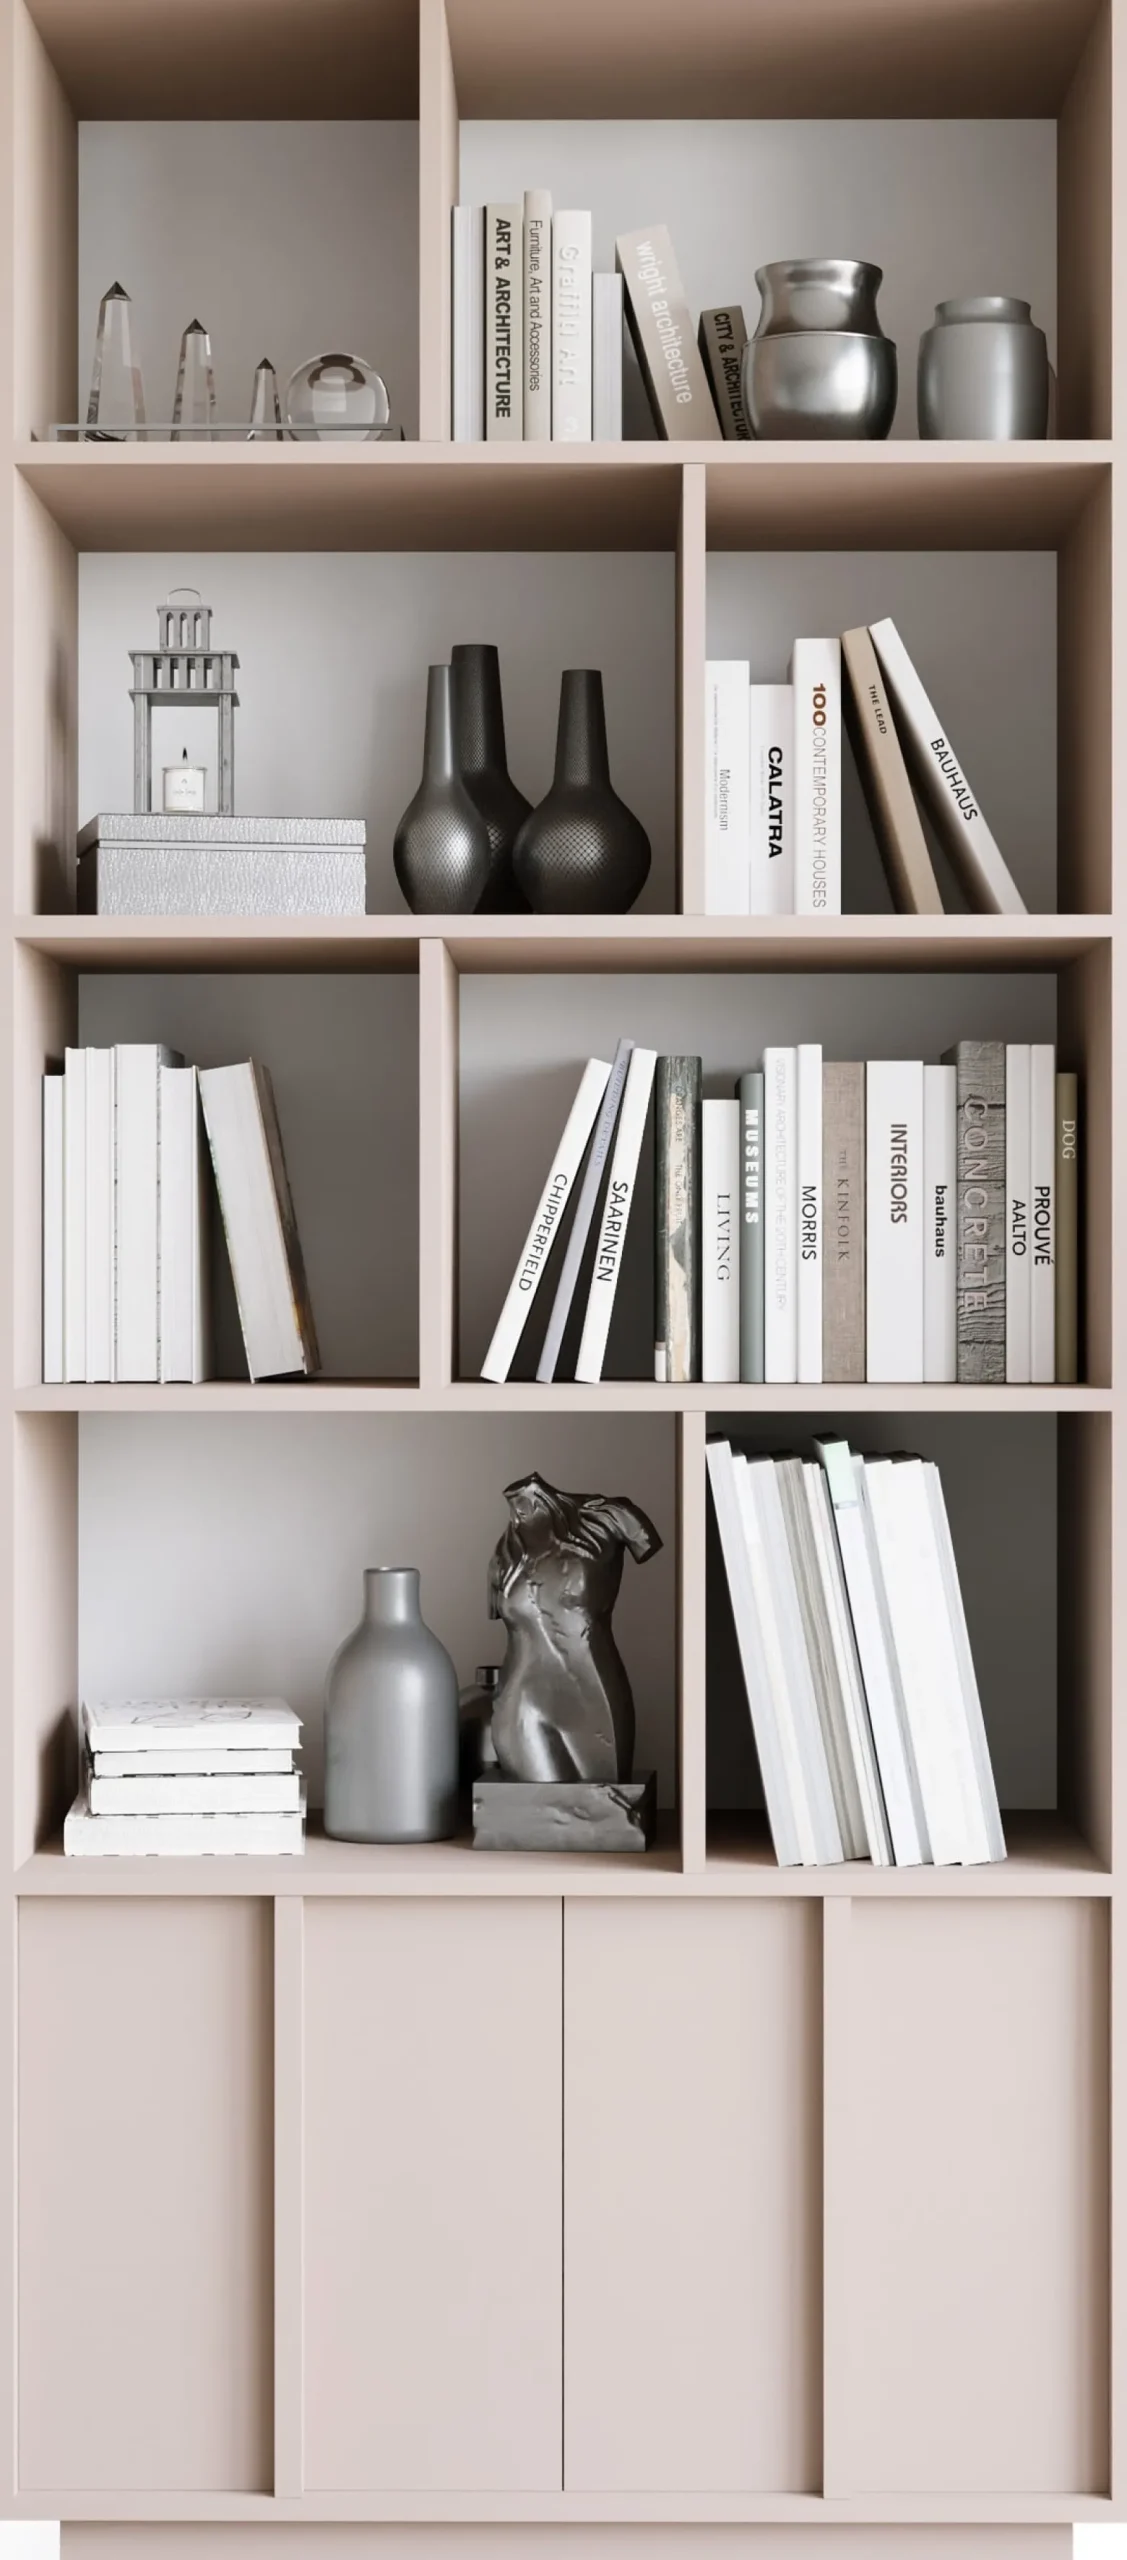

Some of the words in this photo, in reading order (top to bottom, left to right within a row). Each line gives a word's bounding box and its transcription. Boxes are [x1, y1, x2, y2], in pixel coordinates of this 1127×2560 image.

[494, 257, 510, 270] &
[495, 218, 511, 255] ART
[528, 220, 543, 274] Furniture,
[529, 277, 543, 294] Art
[529, 296, 543, 318] and
[635, 240, 667, 297] wright
[651, 300, 693, 404] architecture
[495, 277, 511, 418] ARCHITECTURE
[529, 321, 543, 391] Accessories
[714, 313, 735, 341] CITY
[718, 344, 735, 354] &
[868, 684, 880, 705] THE
[874, 708, 887, 734] LEAD
[719, 769, 731, 831] Modernism
[768, 746, 783, 858] CALATRA
[930, 738, 978, 821] BAUHAUS
[812, 850, 827, 908] HOUSES
[745, 1109, 759, 1224] MUSEUMS
[890, 1124, 908, 1223] INTERIORS
[1062, 1119, 1076, 1160] DOG
[518, 1173, 568, 1291] CHIPPERFIELD
[596, 1181, 629, 1282] SAARINEN
[717, 1193, 731, 1281] LIVING
[801, 1186, 817, 1260] MORRIS
[837, 1178, 850, 1260] KINFOLK
[935, 1185, 948, 1258] bauhaus
[963, 1098, 989, 1308] CONCRETE
[1012, 1200, 1027, 1256] AALTO
[1034, 1186, 1054, 1265] PROUVÉ
